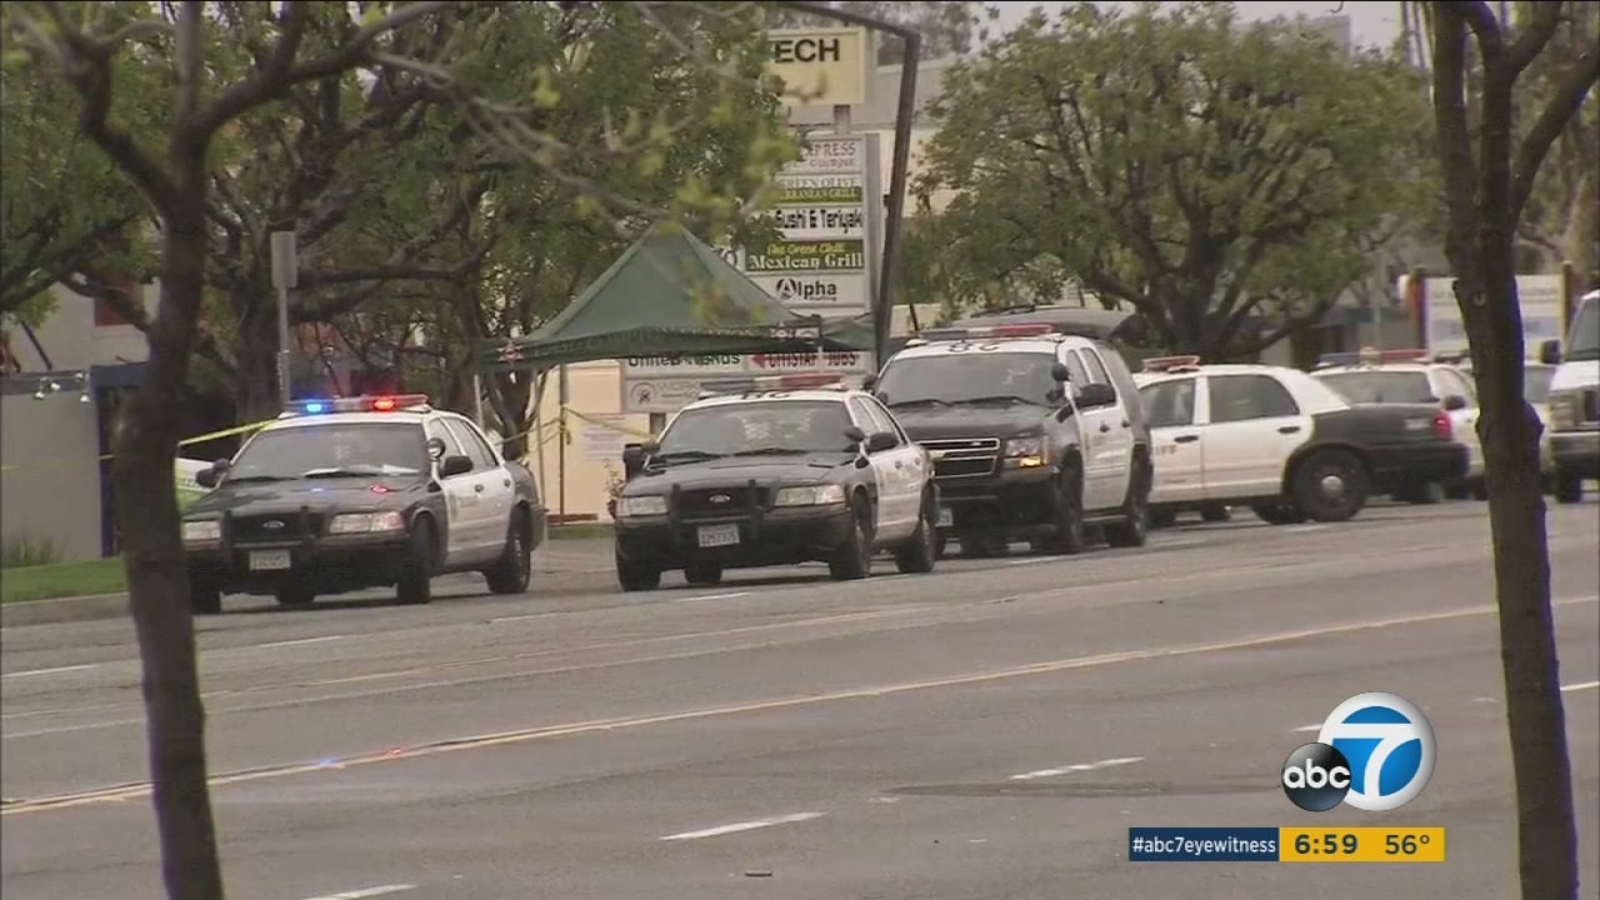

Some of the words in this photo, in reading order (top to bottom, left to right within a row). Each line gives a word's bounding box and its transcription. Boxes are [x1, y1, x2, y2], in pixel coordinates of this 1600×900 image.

[773, 38, 840, 63] ECH
[749, 254, 820, 270] Mexican
[825, 252, 863, 267] Grill
[776, 278, 837, 300] Alpha
